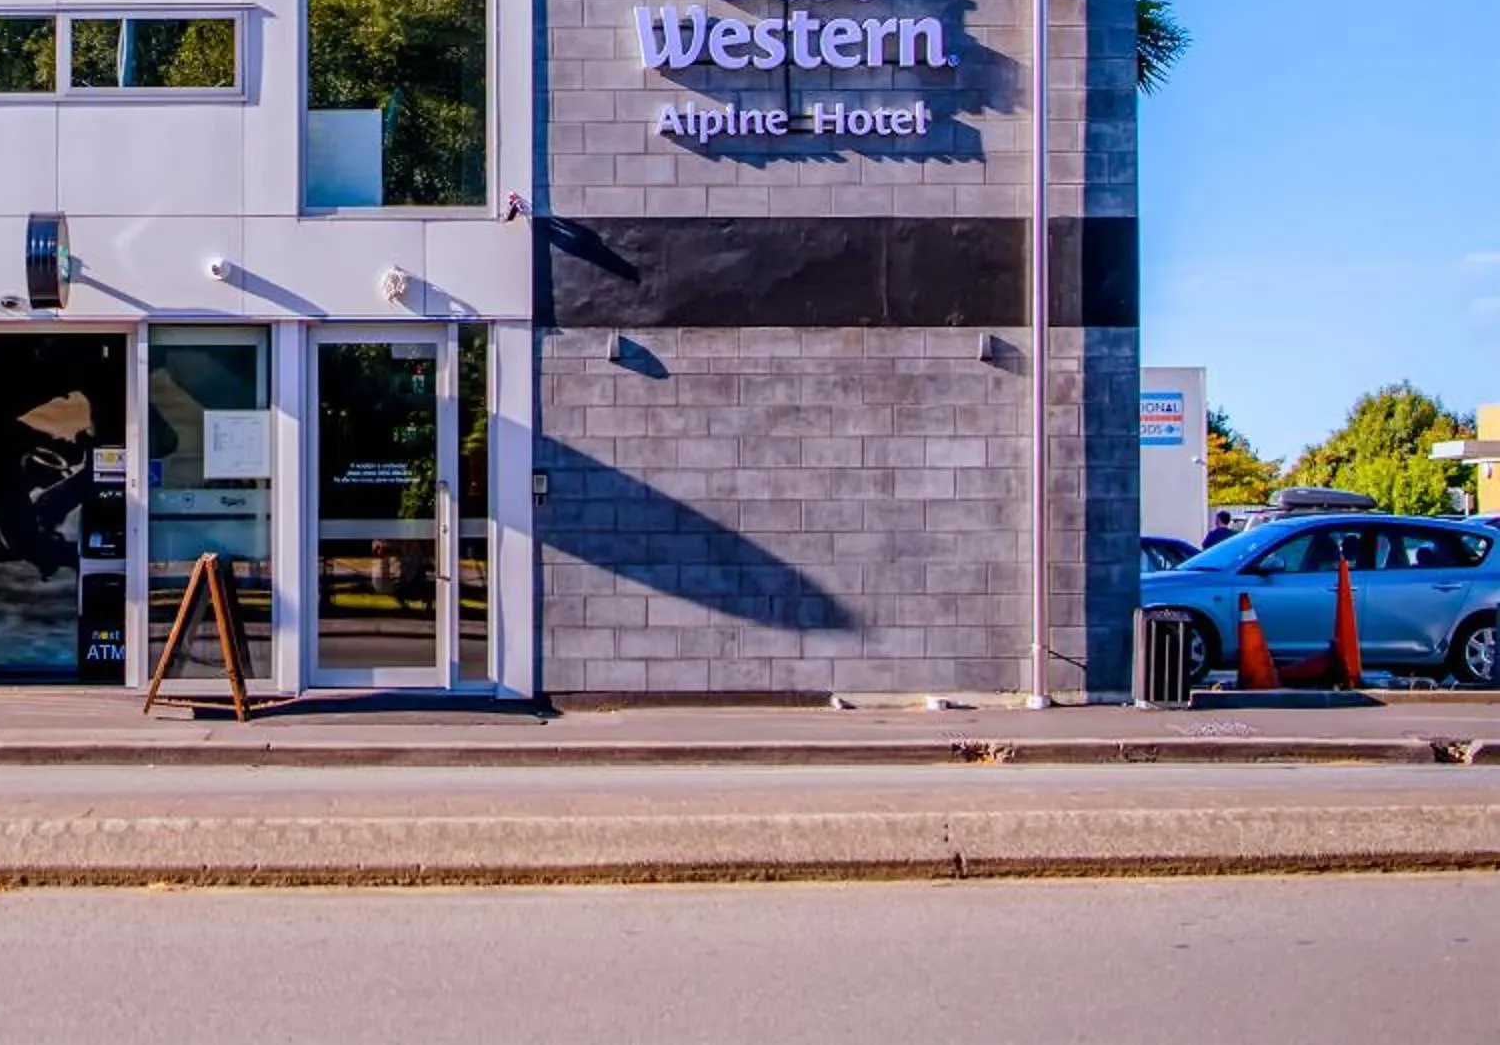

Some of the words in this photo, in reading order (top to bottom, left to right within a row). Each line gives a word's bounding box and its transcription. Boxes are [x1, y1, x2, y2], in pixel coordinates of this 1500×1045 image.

[634, 4, 949, 71] Western
[653, 102, 789, 144] Alpine
[813, 100, 928, 137] Hotel
[85, 644, 125, 660] ATM
